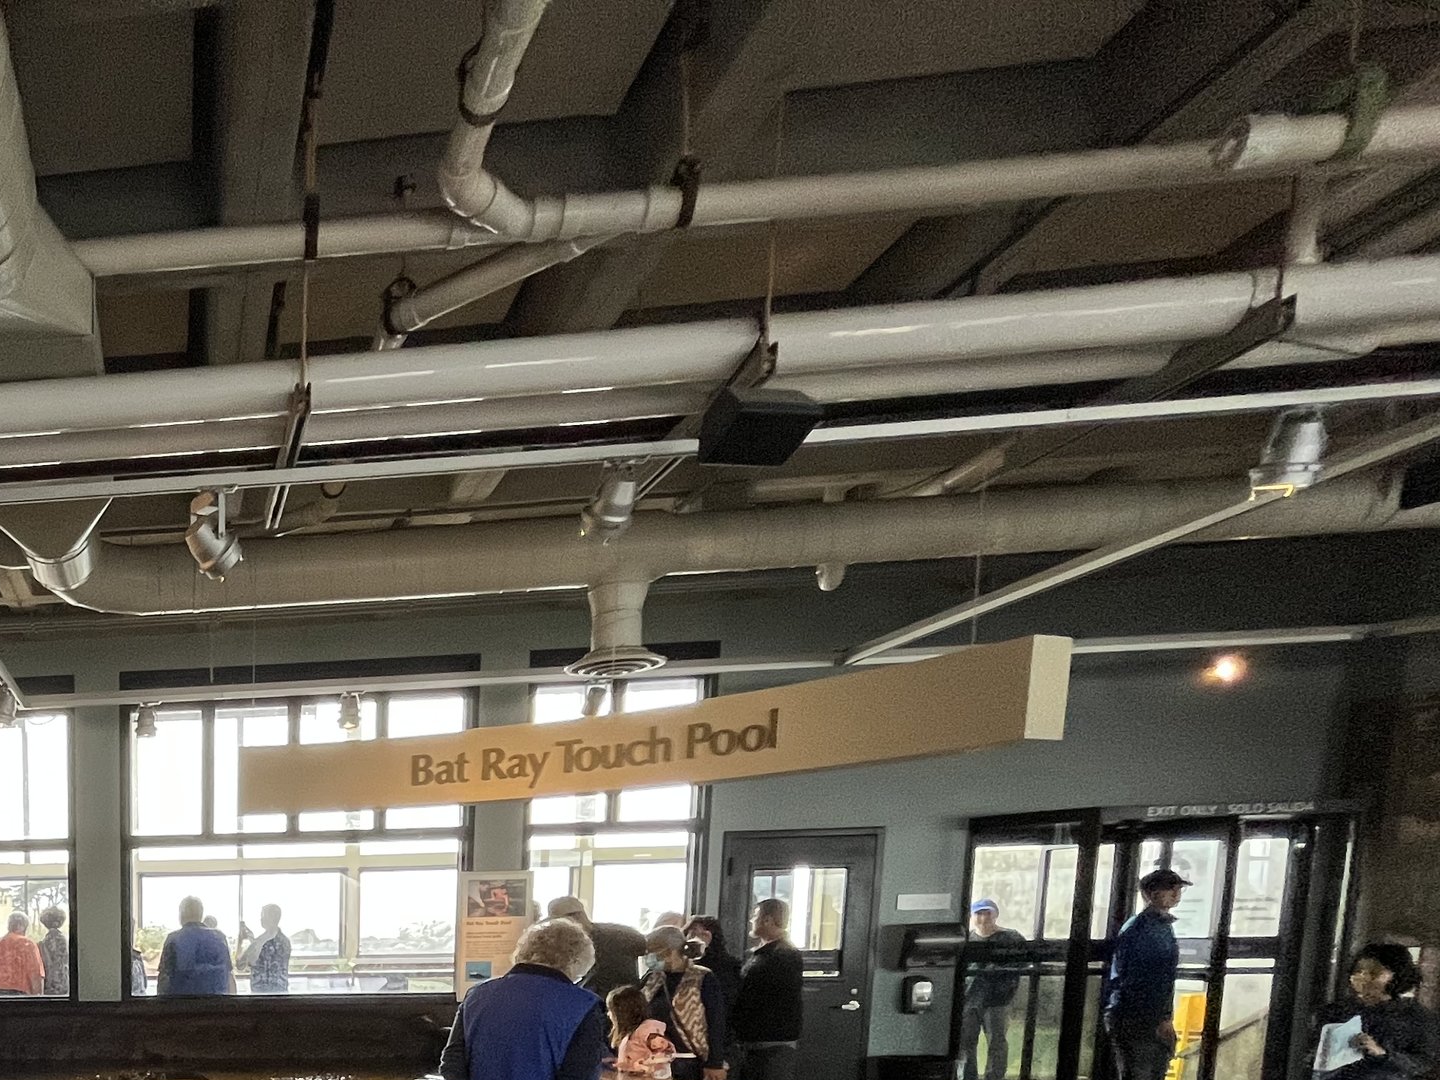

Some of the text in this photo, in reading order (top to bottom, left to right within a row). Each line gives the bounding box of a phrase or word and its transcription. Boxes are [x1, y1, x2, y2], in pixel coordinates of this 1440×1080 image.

[411, 708, 780, 788] Bat Ray Touch Pool
[1147, 806, 1178, 817] EXIT
[1180, 805, 1217, 816] ONLY
